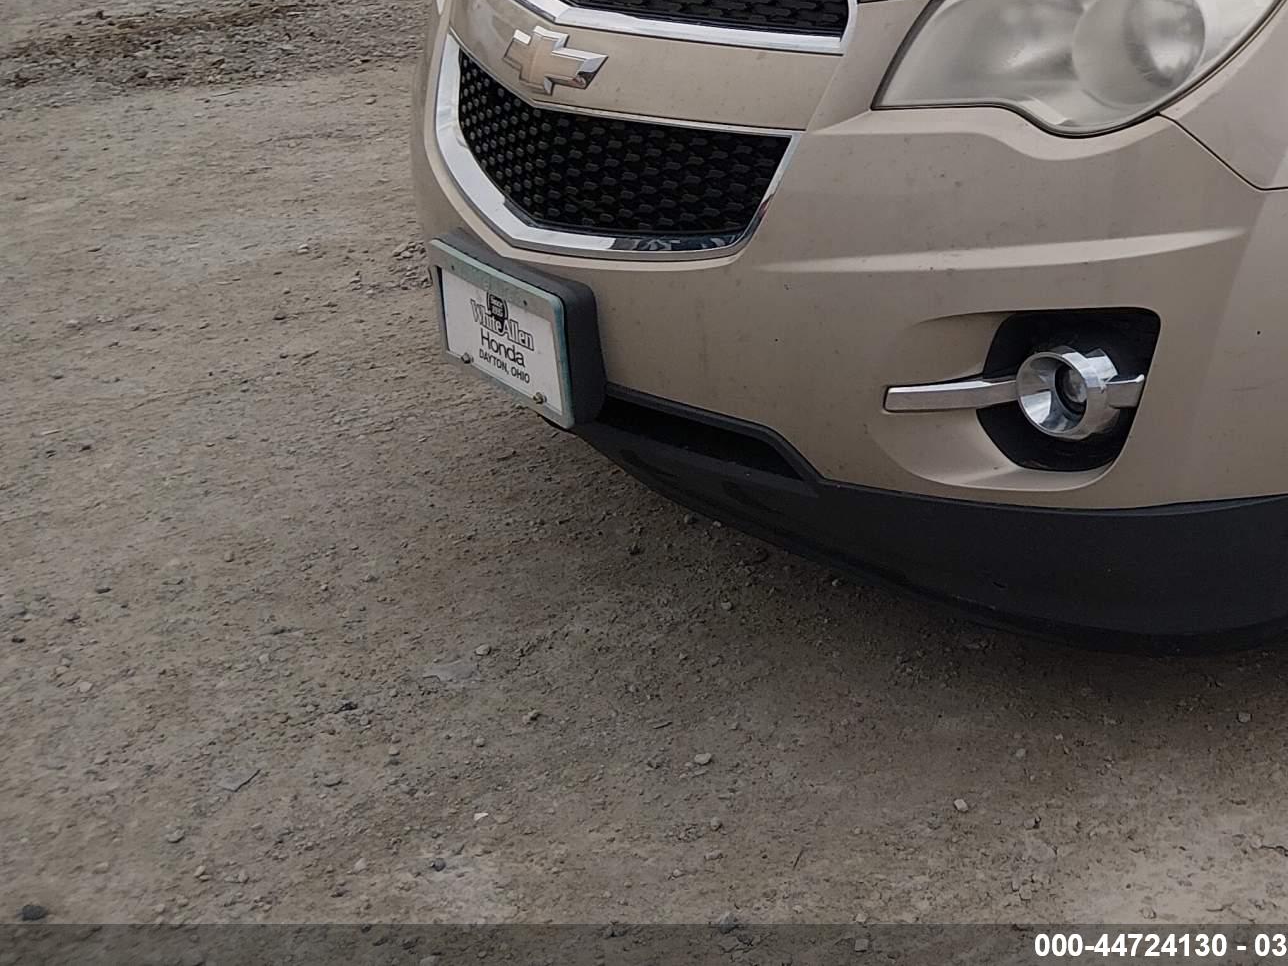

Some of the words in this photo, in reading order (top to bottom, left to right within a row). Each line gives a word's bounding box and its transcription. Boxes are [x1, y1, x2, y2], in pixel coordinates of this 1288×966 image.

[470, 298, 504, 336] White
[503, 317, 535, 352] Allen
[479, 348, 510, 375] DAYTON,
[511, 366, 531, 384] OHIO
[480, 327, 526, 367] Honda
